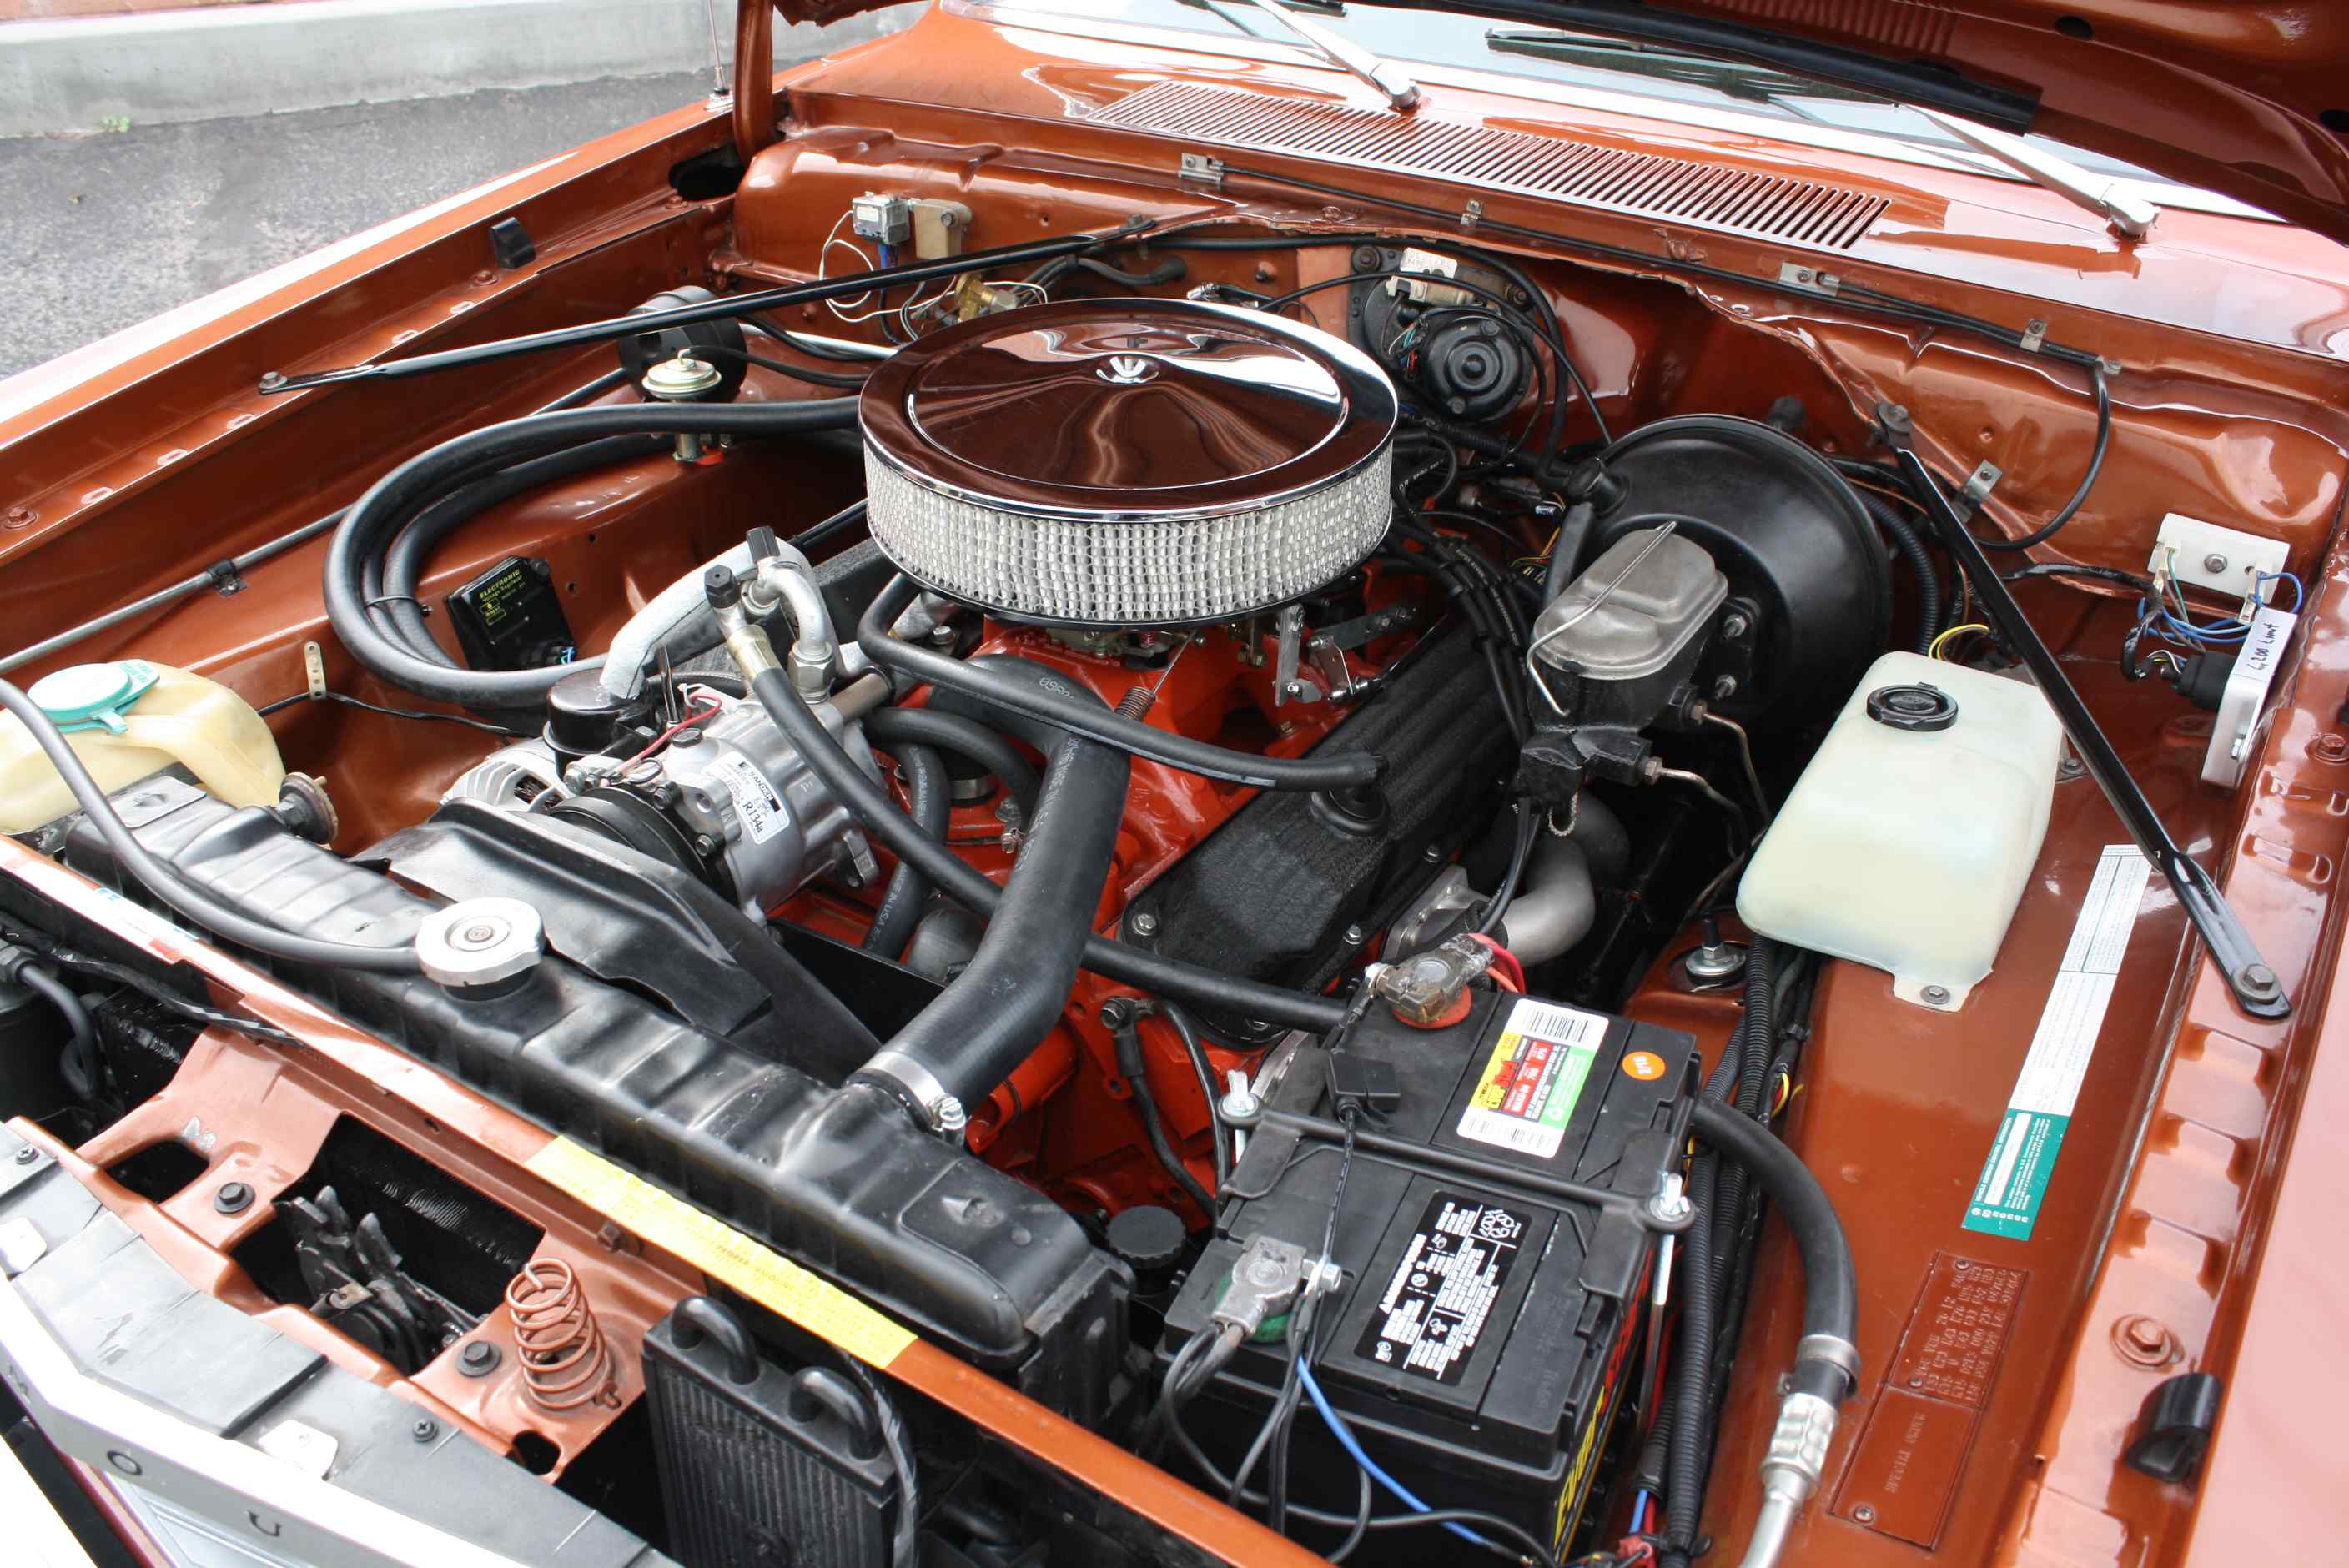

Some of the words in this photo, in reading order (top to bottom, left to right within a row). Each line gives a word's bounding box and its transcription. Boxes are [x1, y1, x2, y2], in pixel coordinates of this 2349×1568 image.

[480, 569, 521, 599] ELECTRONIC
[748, 768, 774, 802] SANDEN
[742, 799, 767, 833] R134a
